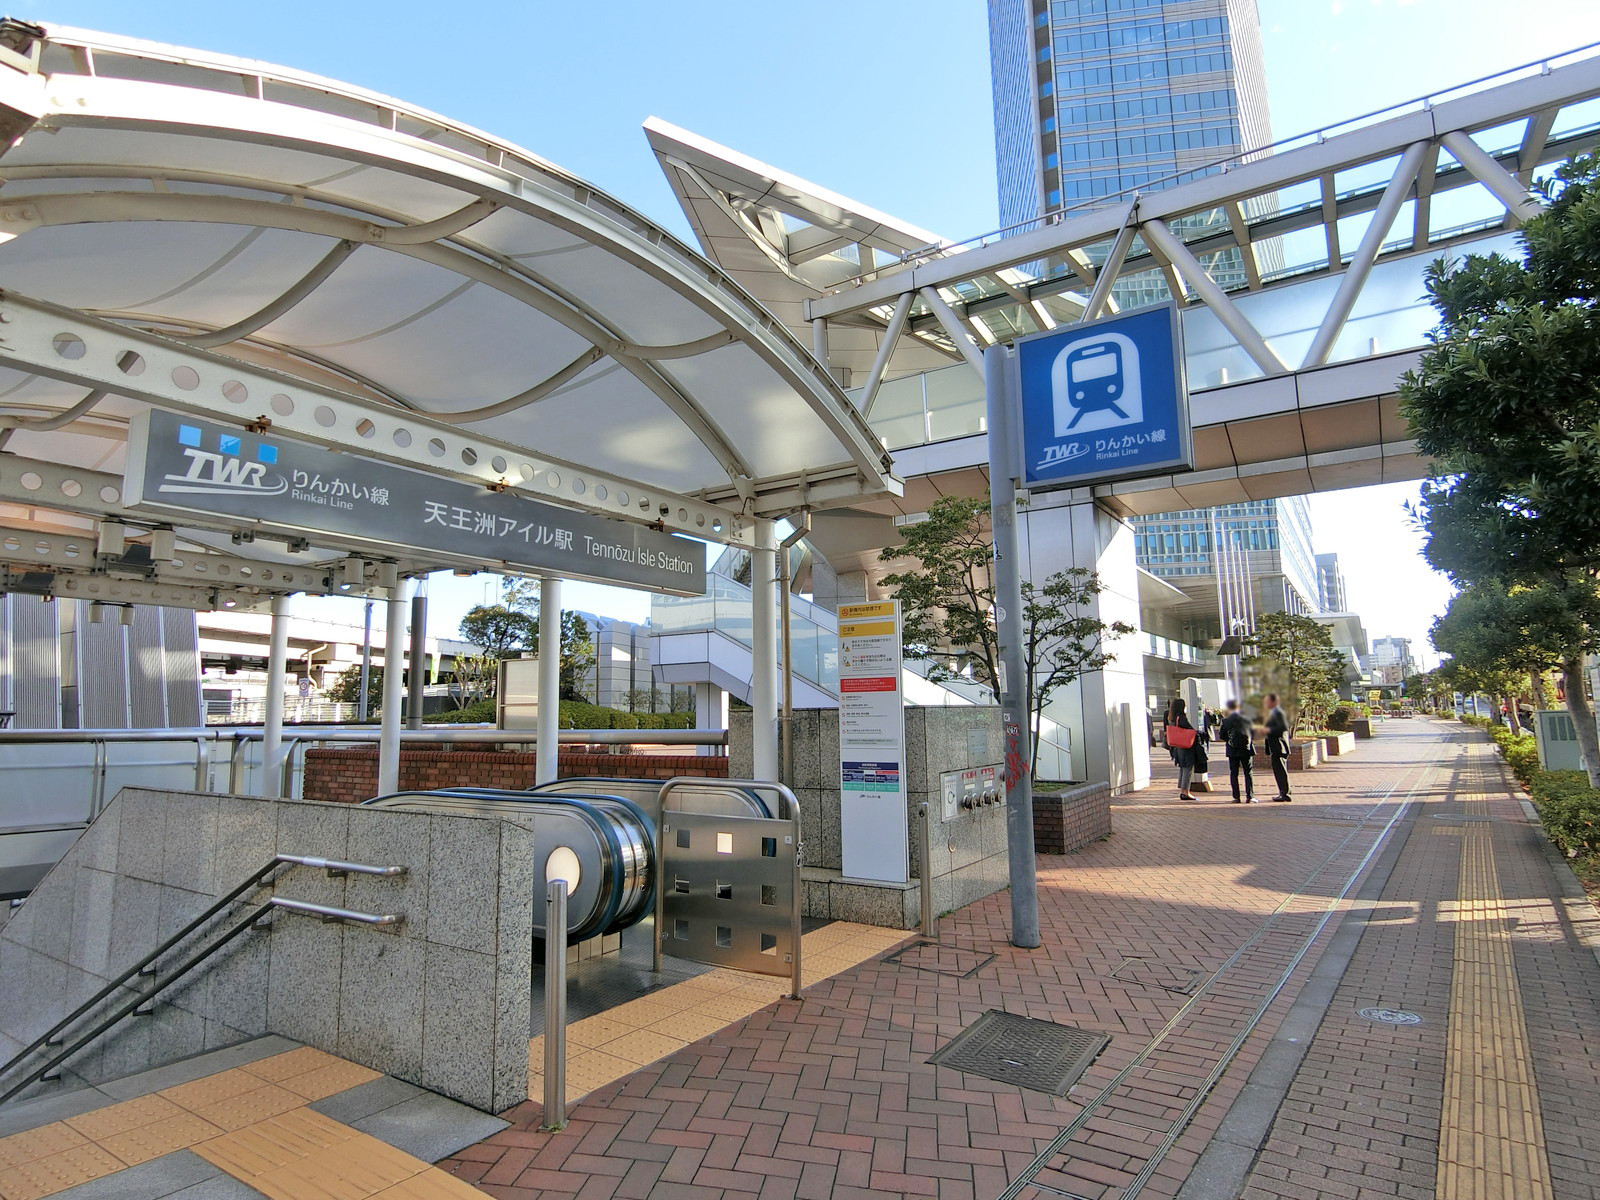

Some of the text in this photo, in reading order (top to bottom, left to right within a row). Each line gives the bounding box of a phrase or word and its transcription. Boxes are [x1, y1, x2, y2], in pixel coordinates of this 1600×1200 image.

[1042, 442, 1080, 463] TWR
[1095, 429, 1167, 452] りんかい線
[1096, 447, 1139, 461] Rinkai Line
[184, 448, 267, 488] TWR
[291, 488, 354, 510] Rinkai Line
[292, 469, 390, 506] りんかい線
[424, 500, 574, 552] 天王洲アイル駅
[583, 535, 694, 575] Tennōzu Isle Station
